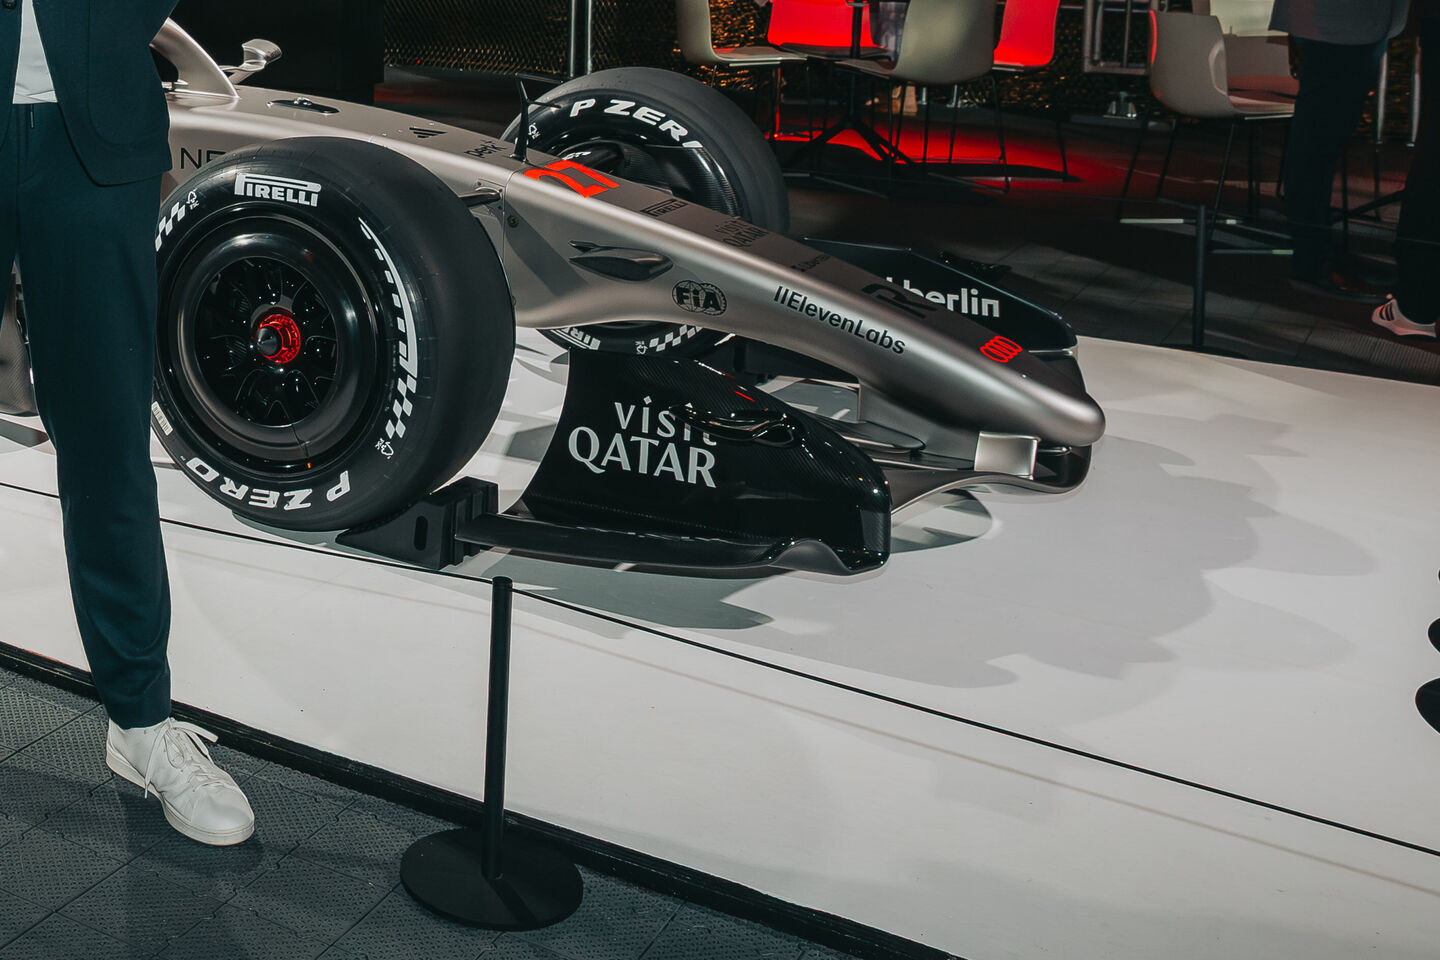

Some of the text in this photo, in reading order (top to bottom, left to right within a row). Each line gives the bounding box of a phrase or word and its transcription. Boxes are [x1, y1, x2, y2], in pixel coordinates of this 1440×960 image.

[569, 98, 596, 118] P
[234, 172, 322, 207] PIRELLI
[639, 198, 689, 218] PIRELLI
[568, 426, 717, 489] QATAR
[186, 457, 351, 511] P ZERO
